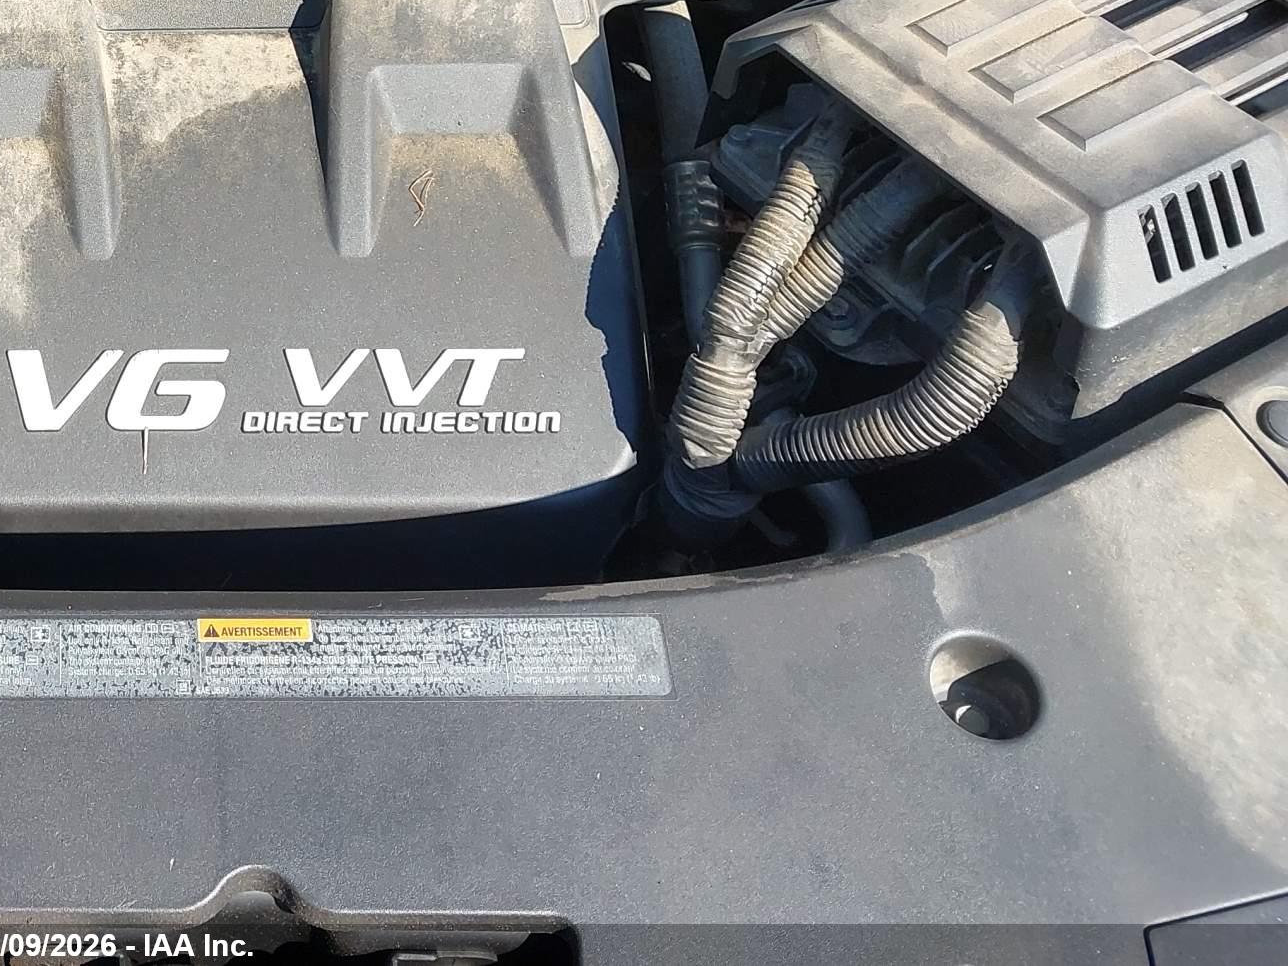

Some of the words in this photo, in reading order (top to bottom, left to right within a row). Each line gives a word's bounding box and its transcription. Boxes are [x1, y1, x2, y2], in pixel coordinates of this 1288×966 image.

[283, 347, 526, 408] VVT
[6, 348, 230, 433] V6
[240, 410, 370, 434] DIRECT
[380, 410, 562, 435] INJECTION
[221, 627, 304, 638] AVERTISSEMENT
[324, 656, 346, 666] SOUS
[347, 656, 375, 666] HAUTE
